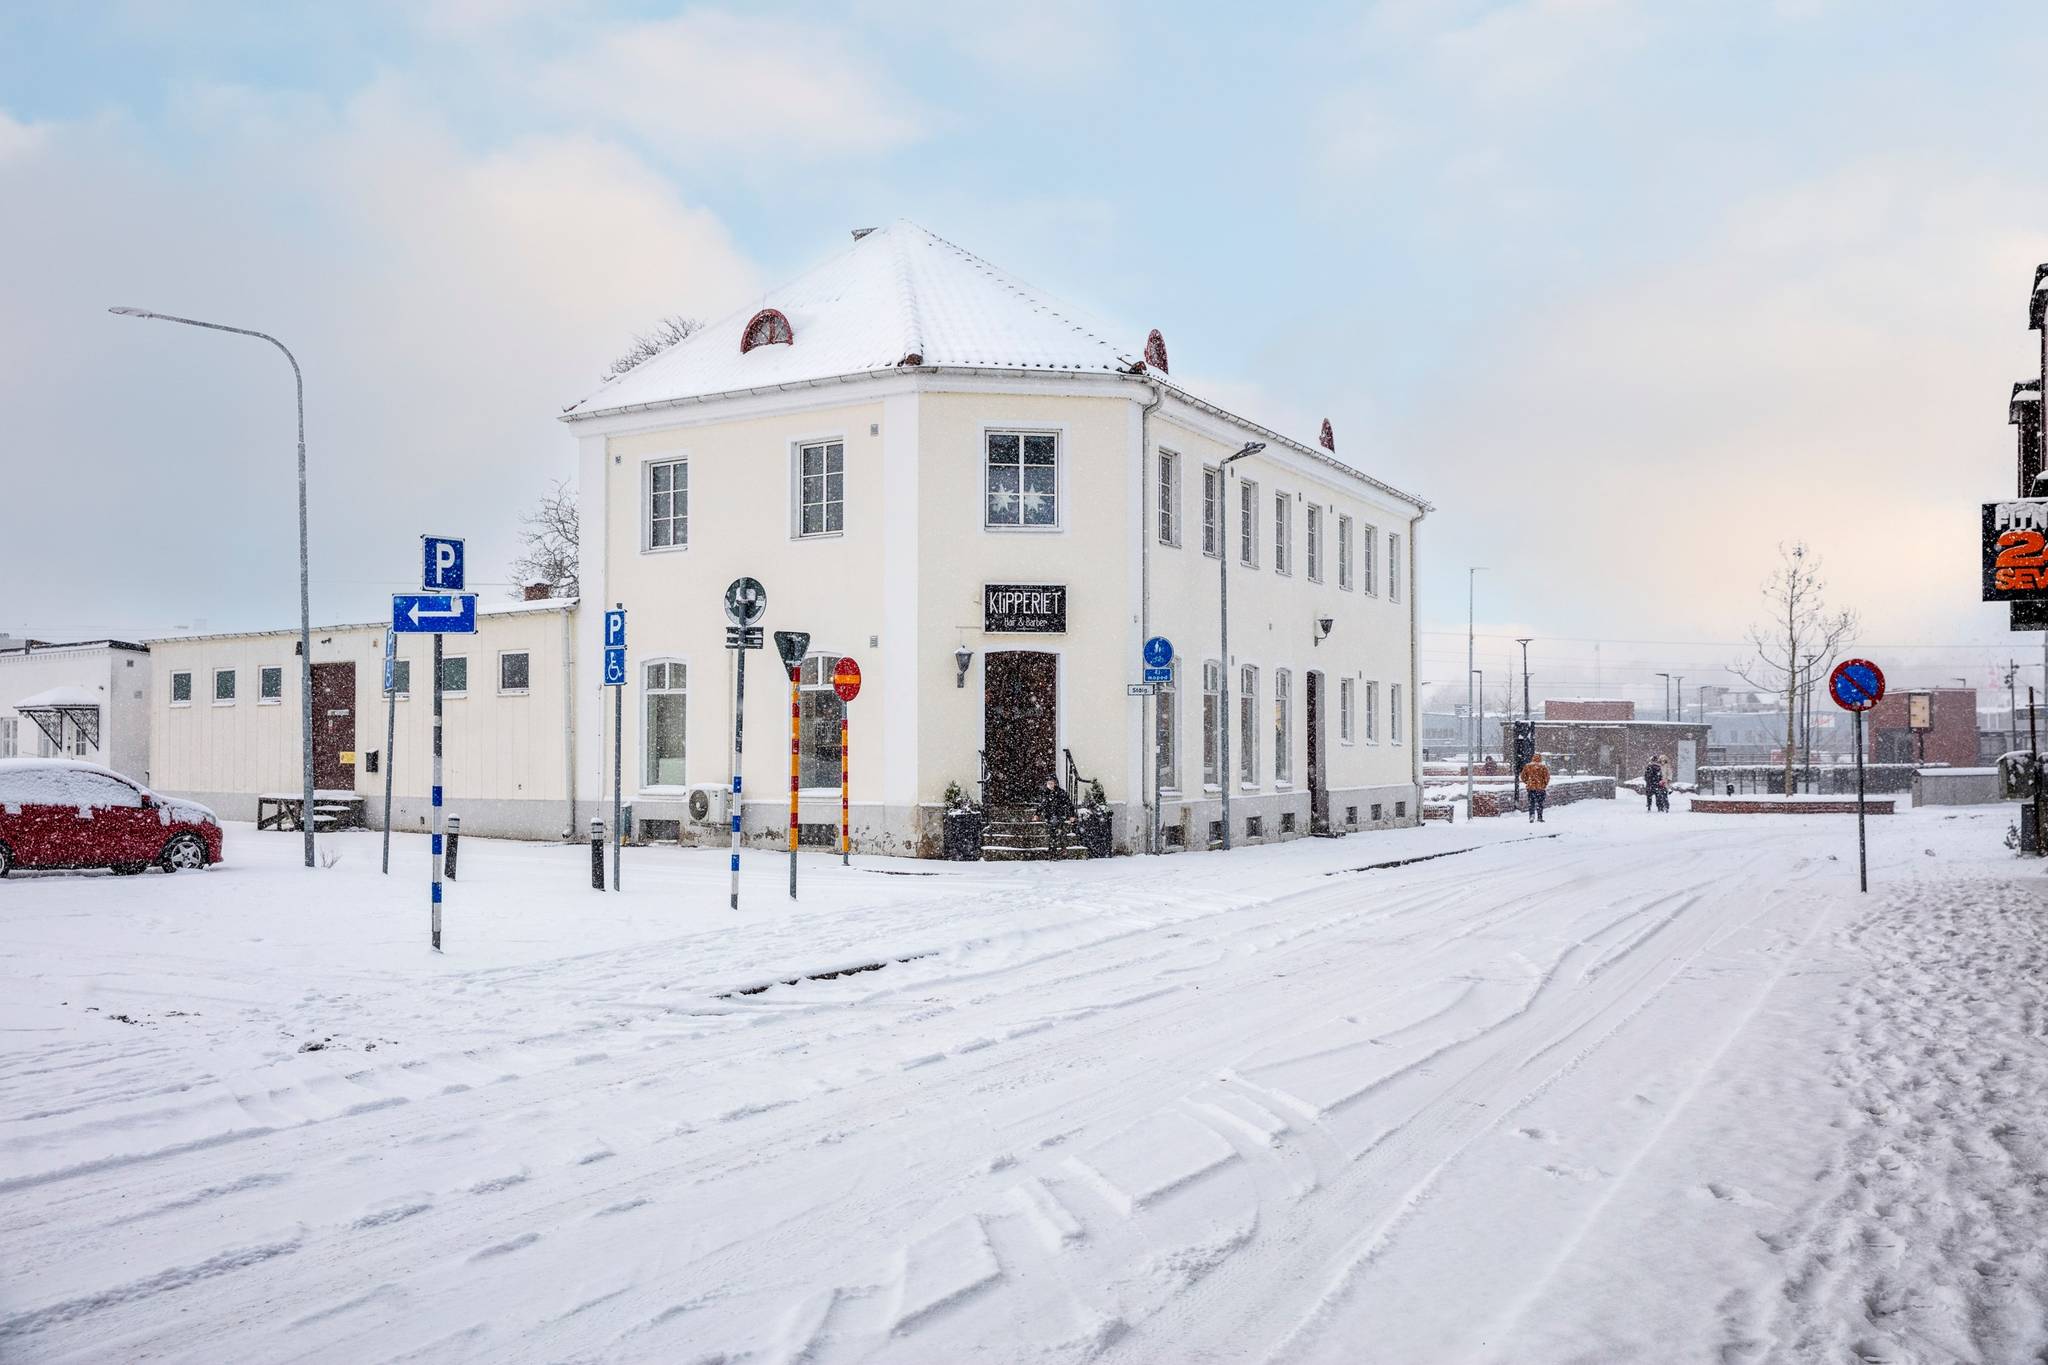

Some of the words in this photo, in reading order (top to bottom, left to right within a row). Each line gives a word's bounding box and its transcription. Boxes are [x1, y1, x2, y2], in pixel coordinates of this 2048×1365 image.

[436, 543, 455, 584] P
[1995, 530, 2048, 567] 2
[610, 614, 622, 643] P
